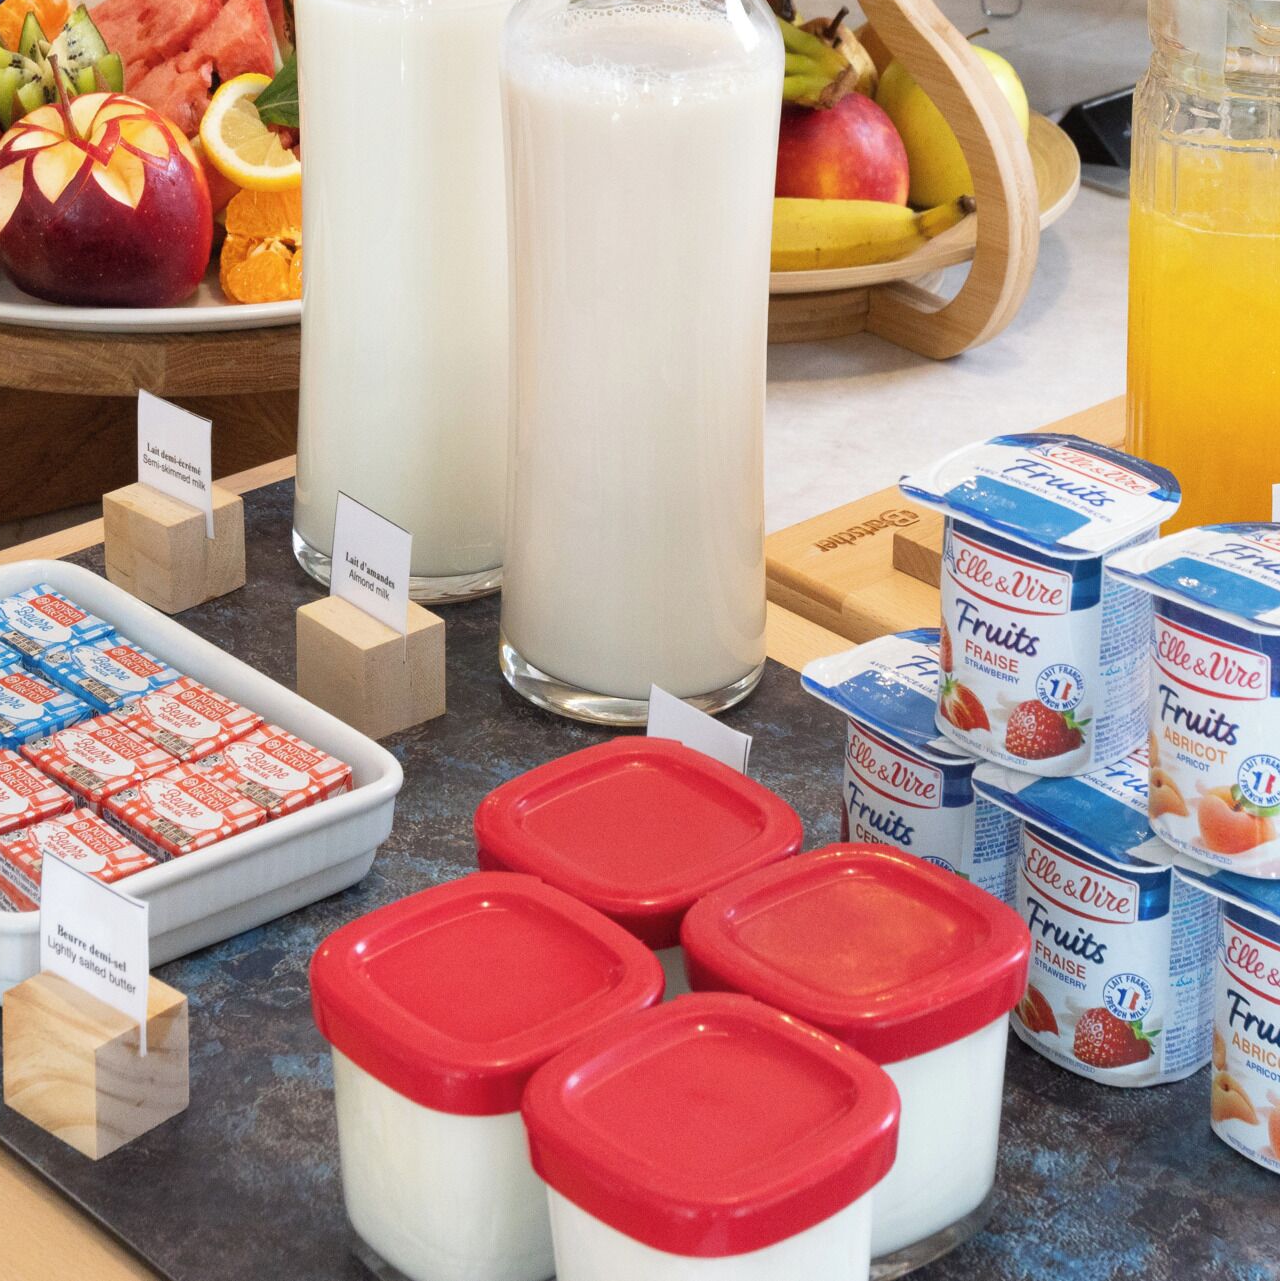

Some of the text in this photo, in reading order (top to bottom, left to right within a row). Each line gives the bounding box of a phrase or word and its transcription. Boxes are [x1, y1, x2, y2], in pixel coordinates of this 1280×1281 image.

[146, 441, 160, 455] Lait
[192, 478, 206, 492] milk
[1003, 458, 1115, 508] Fruits
[345, 551, 396, 590] Lait d'amandes
[348, 569, 390, 601] Almond milk
[956, 547, 994, 588] Elle
[1010, 570, 1064, 606] Vire
[14, 605, 55, 632] Beurre
[955, 597, 1041, 657] Fruits
[90, 655, 131, 682] Beurre
[964, 639, 1019, 674] FRAISE
[964, 657, 1020, 685] STRAWBERRY
[1157, 630, 1191, 671] Elle
[1210, 652, 1263, 690] Vire
[159, 701, 202, 729] Beurre
[1158, 684, 1241, 746] Fruits
[73, 737, 116, 765] Beurre
[1163, 725, 1228, 765] ABRICOT
[1176, 752, 1211, 773] APRICOT
[244, 751, 290, 780] Beurre
[849, 734, 877, 775] Elle
[890, 761, 937, 799] Vire
[160, 788, 204, 818] Beurre
[1082, 774, 1125, 797] ORCEAUX
[848, 780, 916, 846] Fruits
[47, 830, 88, 861] Beurre
[1026, 847, 1062, 890] Elle
[1079, 874, 1130, 915] Vire
[57, 923, 127, 973] Beurre demi-sel
[1026, 895, 1107, 965] Fruits
[47, 934, 137, 996] Lightly salted butter
[1033, 956, 1088, 992] STRAWBERRY
[1035, 939, 1087, 981] FRAISE
[1226, 934, 1266, 980] Elle
